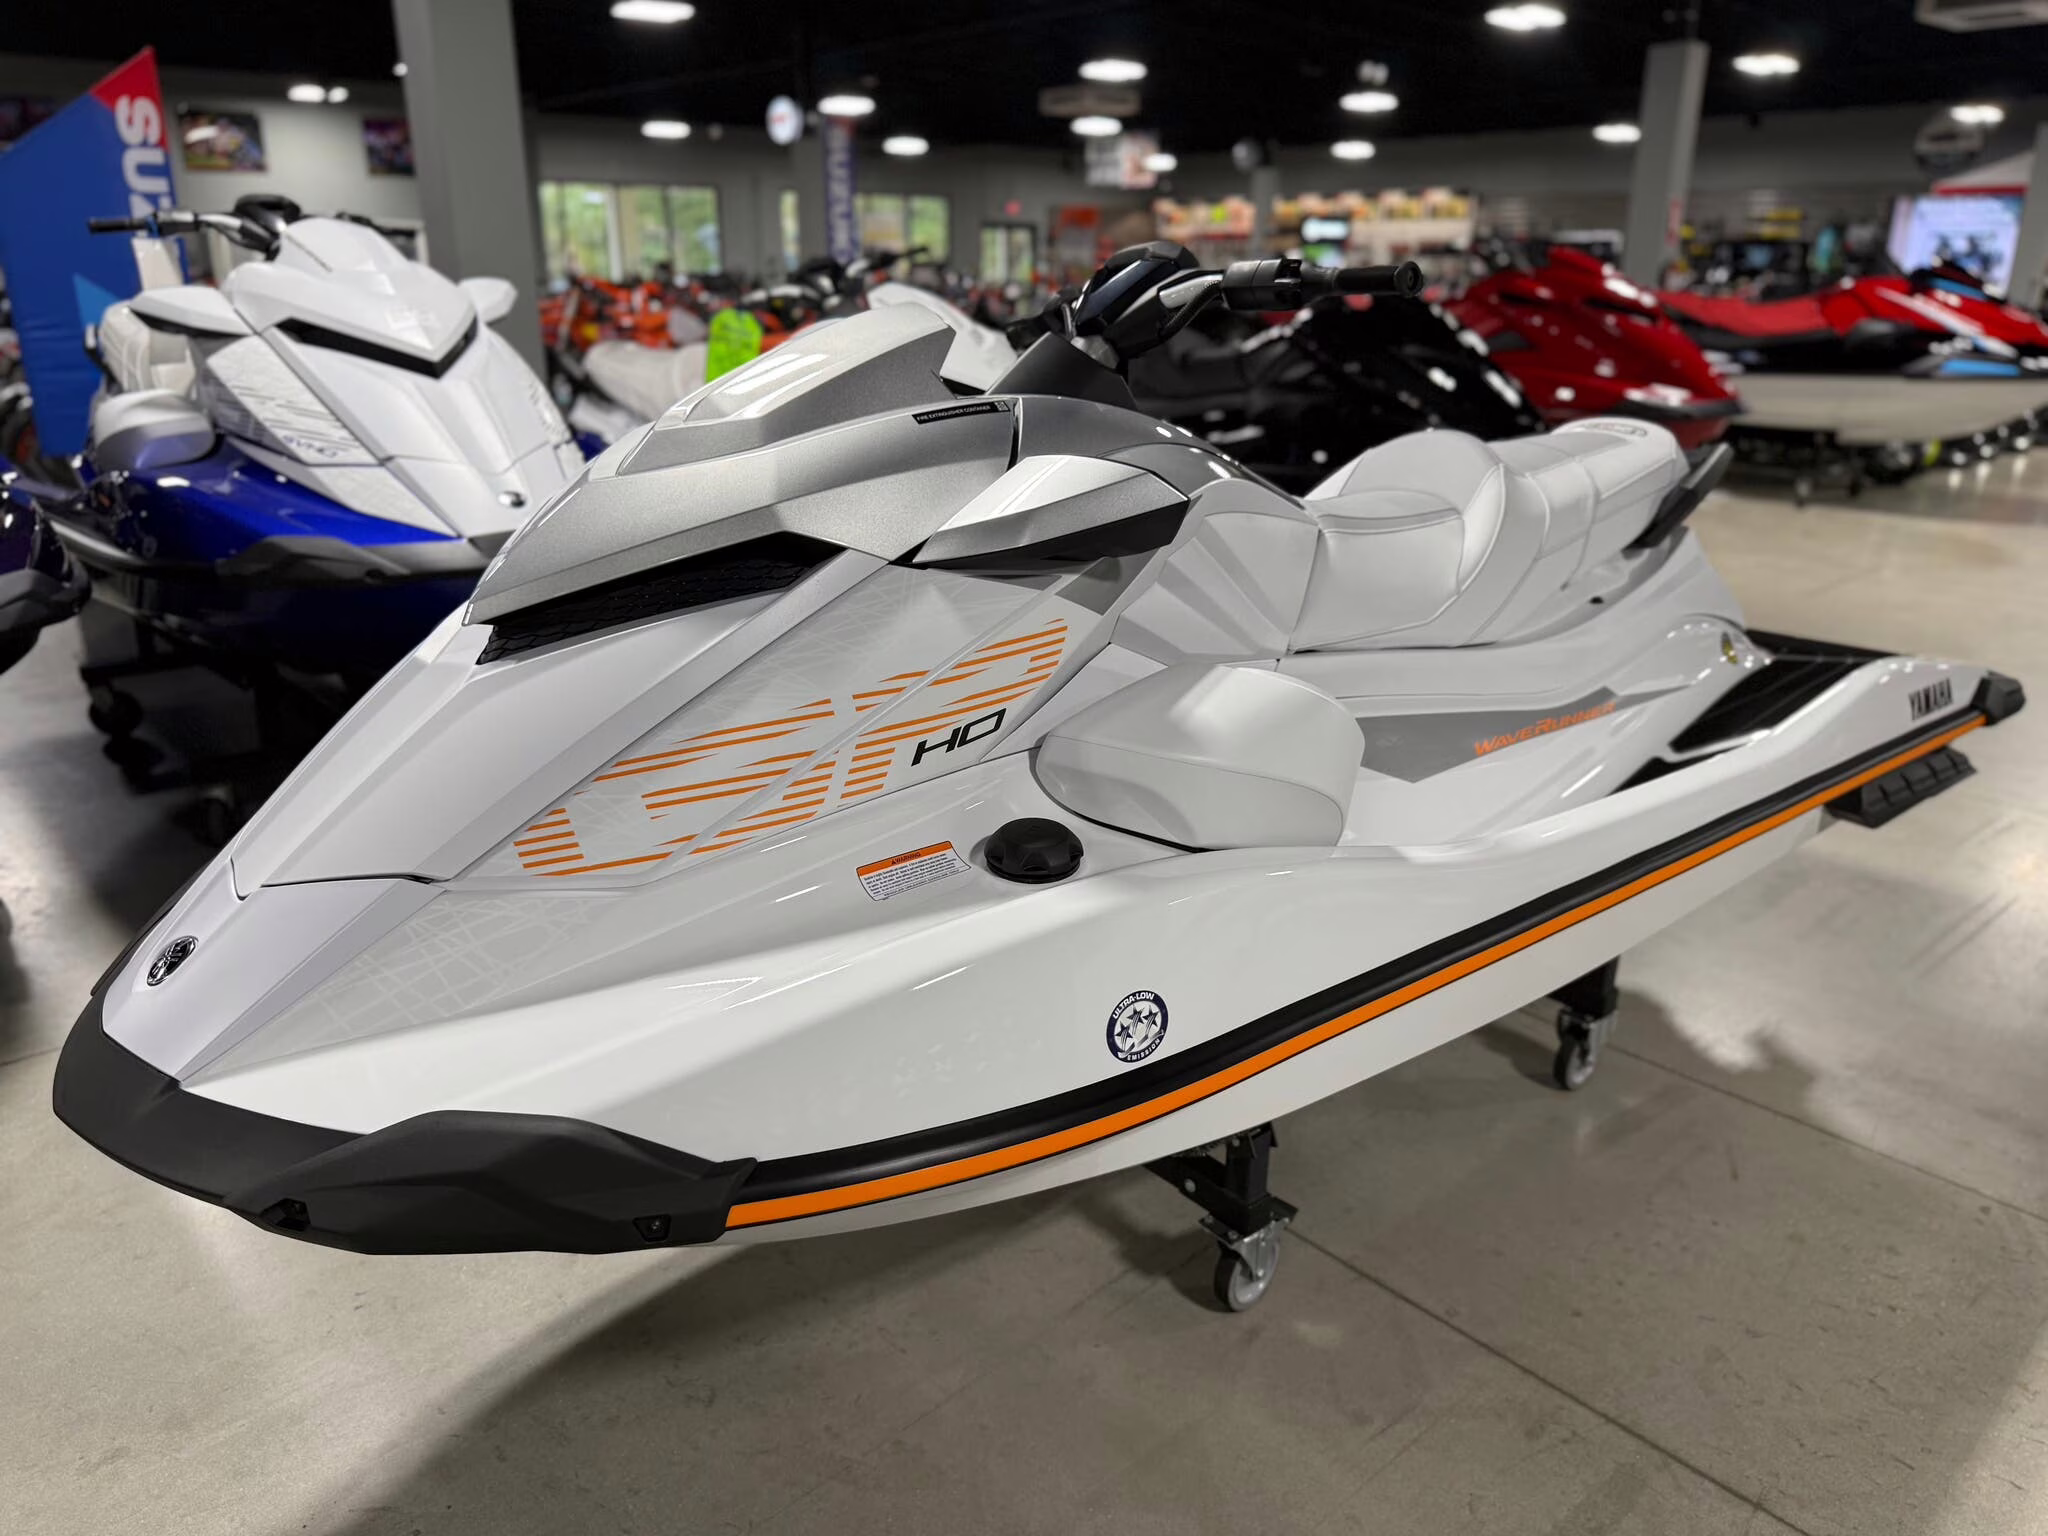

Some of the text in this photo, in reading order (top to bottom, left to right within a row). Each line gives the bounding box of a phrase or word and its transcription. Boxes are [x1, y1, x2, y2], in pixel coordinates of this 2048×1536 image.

[114, 94, 173, 237] SUZ
[1907, 678, 1953, 722] YAMAHA
[910, 707, 1007, 767] HO
[1112, 991, 1155, 1020] ULTRA-LOW
[1127, 1038, 1161, 1061] EMISSION
